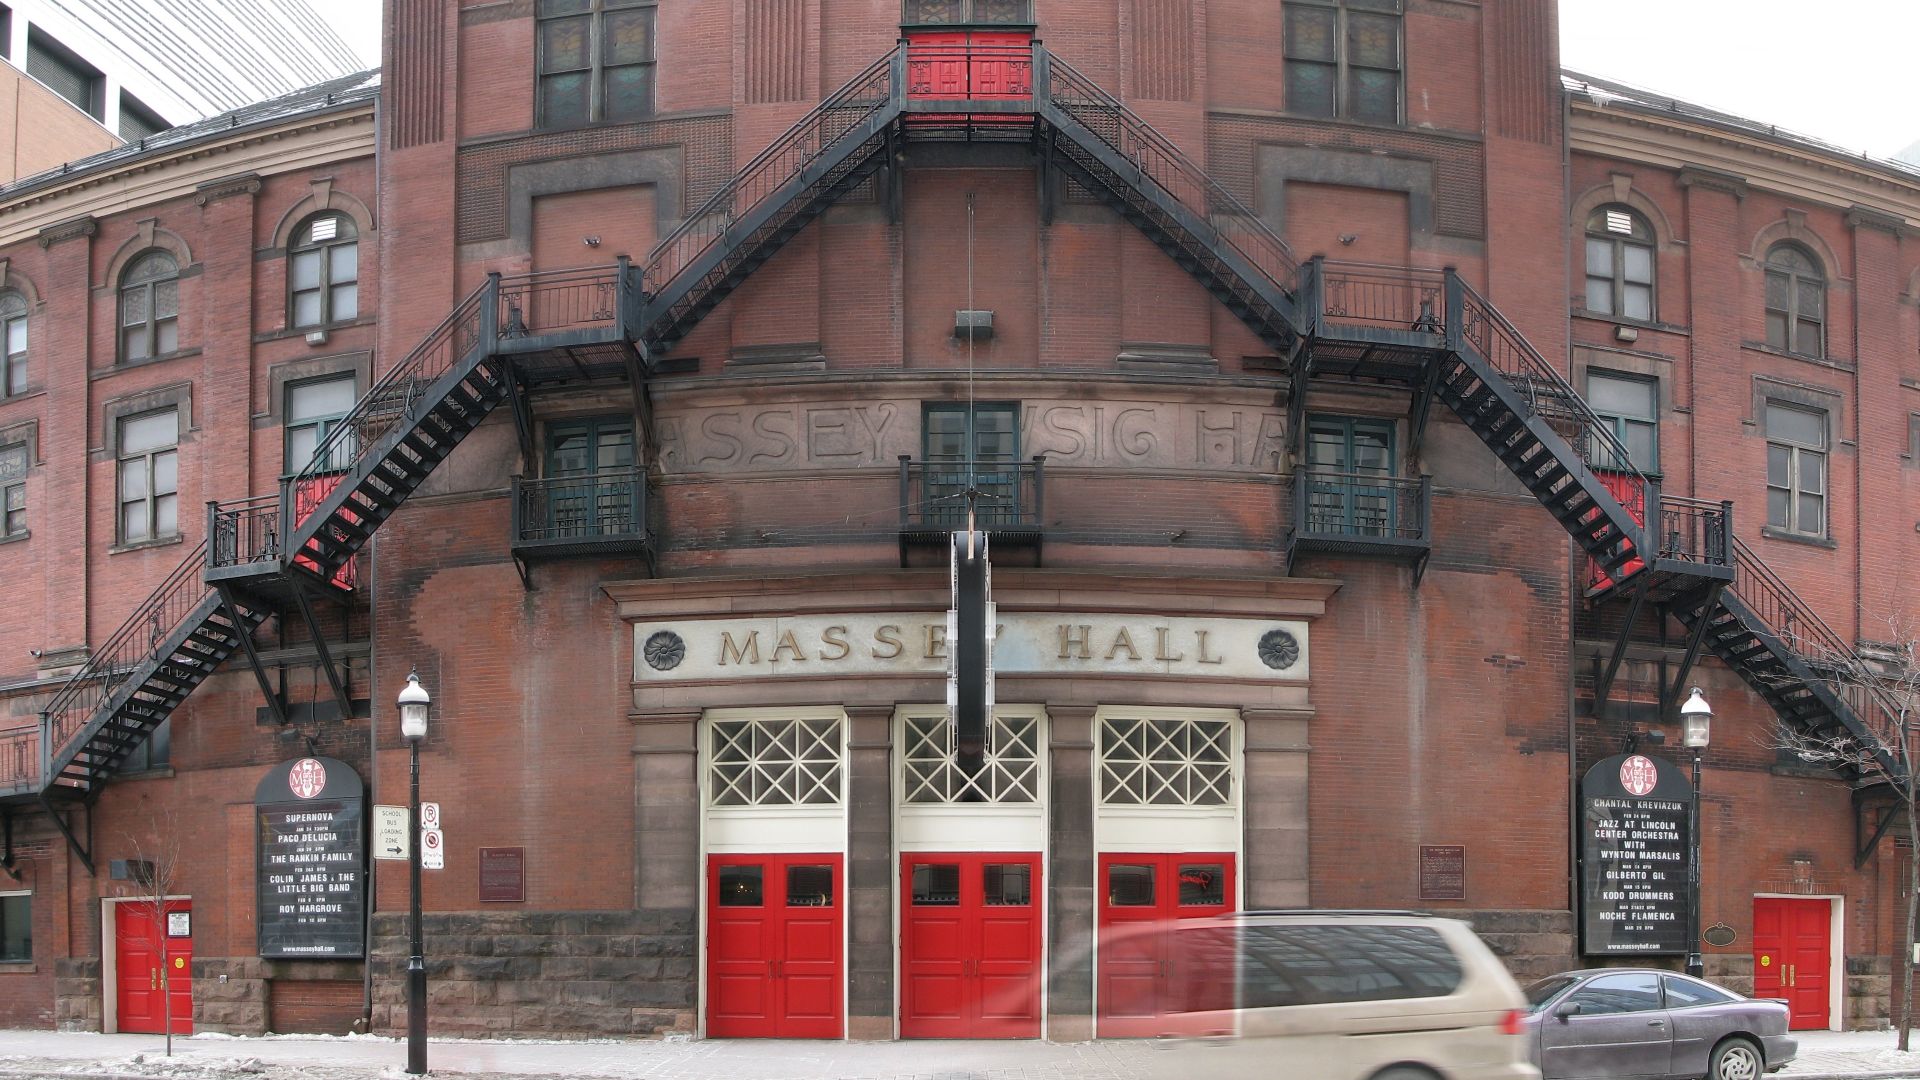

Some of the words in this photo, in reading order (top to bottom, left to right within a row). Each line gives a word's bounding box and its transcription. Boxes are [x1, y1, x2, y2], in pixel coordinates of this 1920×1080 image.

[718, 623, 1003, 666] MASSE
[1057, 624, 1223, 664] HALL
[1594, 799, 1631, 808] CHANTAL
[1637, 800, 1682, 810] KREVIAZUK
[286, 813, 333, 822] SUPERNOVA
[1598, 820, 1619, 828] JAZZ
[1624, 821, 1635, 829] AT
[1641, 821, 1676, 830] LINCOLN
[278, 834, 299, 843] PACO
[302, 833, 337, 841] DELUCIA
[1594, 830, 1627, 839] CENTER
[1631, 831, 1679, 840] ORCHESTRA
[1624, 841, 1646, 849] WITH
[271, 855, 287, 863] THE
[289, 854, 319, 863] RANKIN
[321, 853, 353, 862] FAMILY
[1600, 850, 1636, 859] WYNTON
[1639, 852, 1681, 860] MARSALIS
[270, 875, 294, 883] COLIN
[300, 874, 328, 883] JAMES
[338, 873, 355, 881] THE
[1606, 871, 1647, 879] GILBERTO
[1652, 872, 1666, 880] GIL
[277, 885, 306, 893] LITTLE
[310, 884, 324, 893] BIG
[328, 883, 350, 892] BAND
[1603, 891, 1625, 900] KODO
[1628, 892, 1674, 900] DRUMMERS
[279, 905, 295, 913] ROY
[299, 904, 342, 913] HARGROVE
[1599, 912, 1626, 920] NOCHE
[1631, 912, 1675, 920] FLAMENCA
